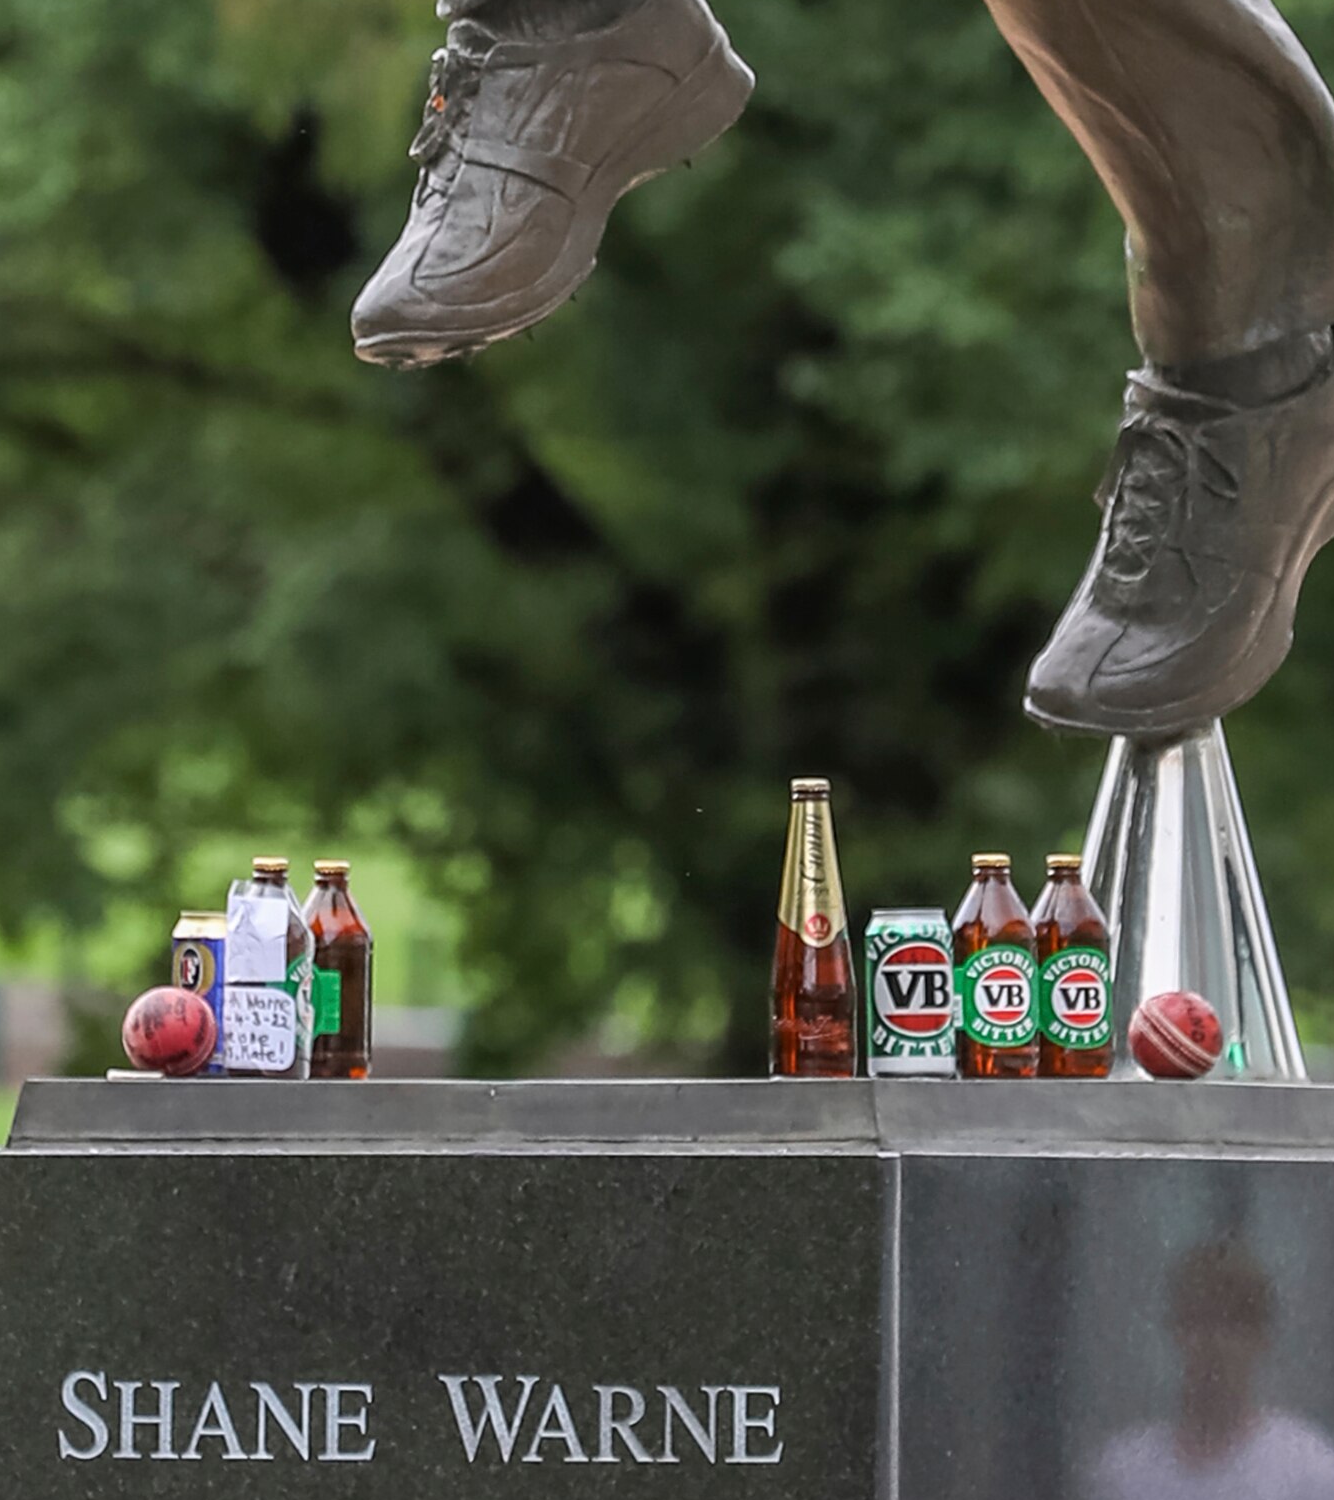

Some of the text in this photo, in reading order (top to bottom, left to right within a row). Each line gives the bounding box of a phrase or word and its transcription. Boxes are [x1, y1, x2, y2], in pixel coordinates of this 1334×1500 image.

[966, 951, 1034, 979] VICTORIA
[1043, 954, 1109, 982] VICTORIA
[881, 970, 951, 1009] VB
[982, 984, 1025, 1008] VB
[1059, 987, 1101, 1011] VB
[971, 1017, 1034, 1041] BITTER
[1048, 1020, 1110, 1045] BITTER
[57, 1369, 784, 1466] SHANE WARNE
